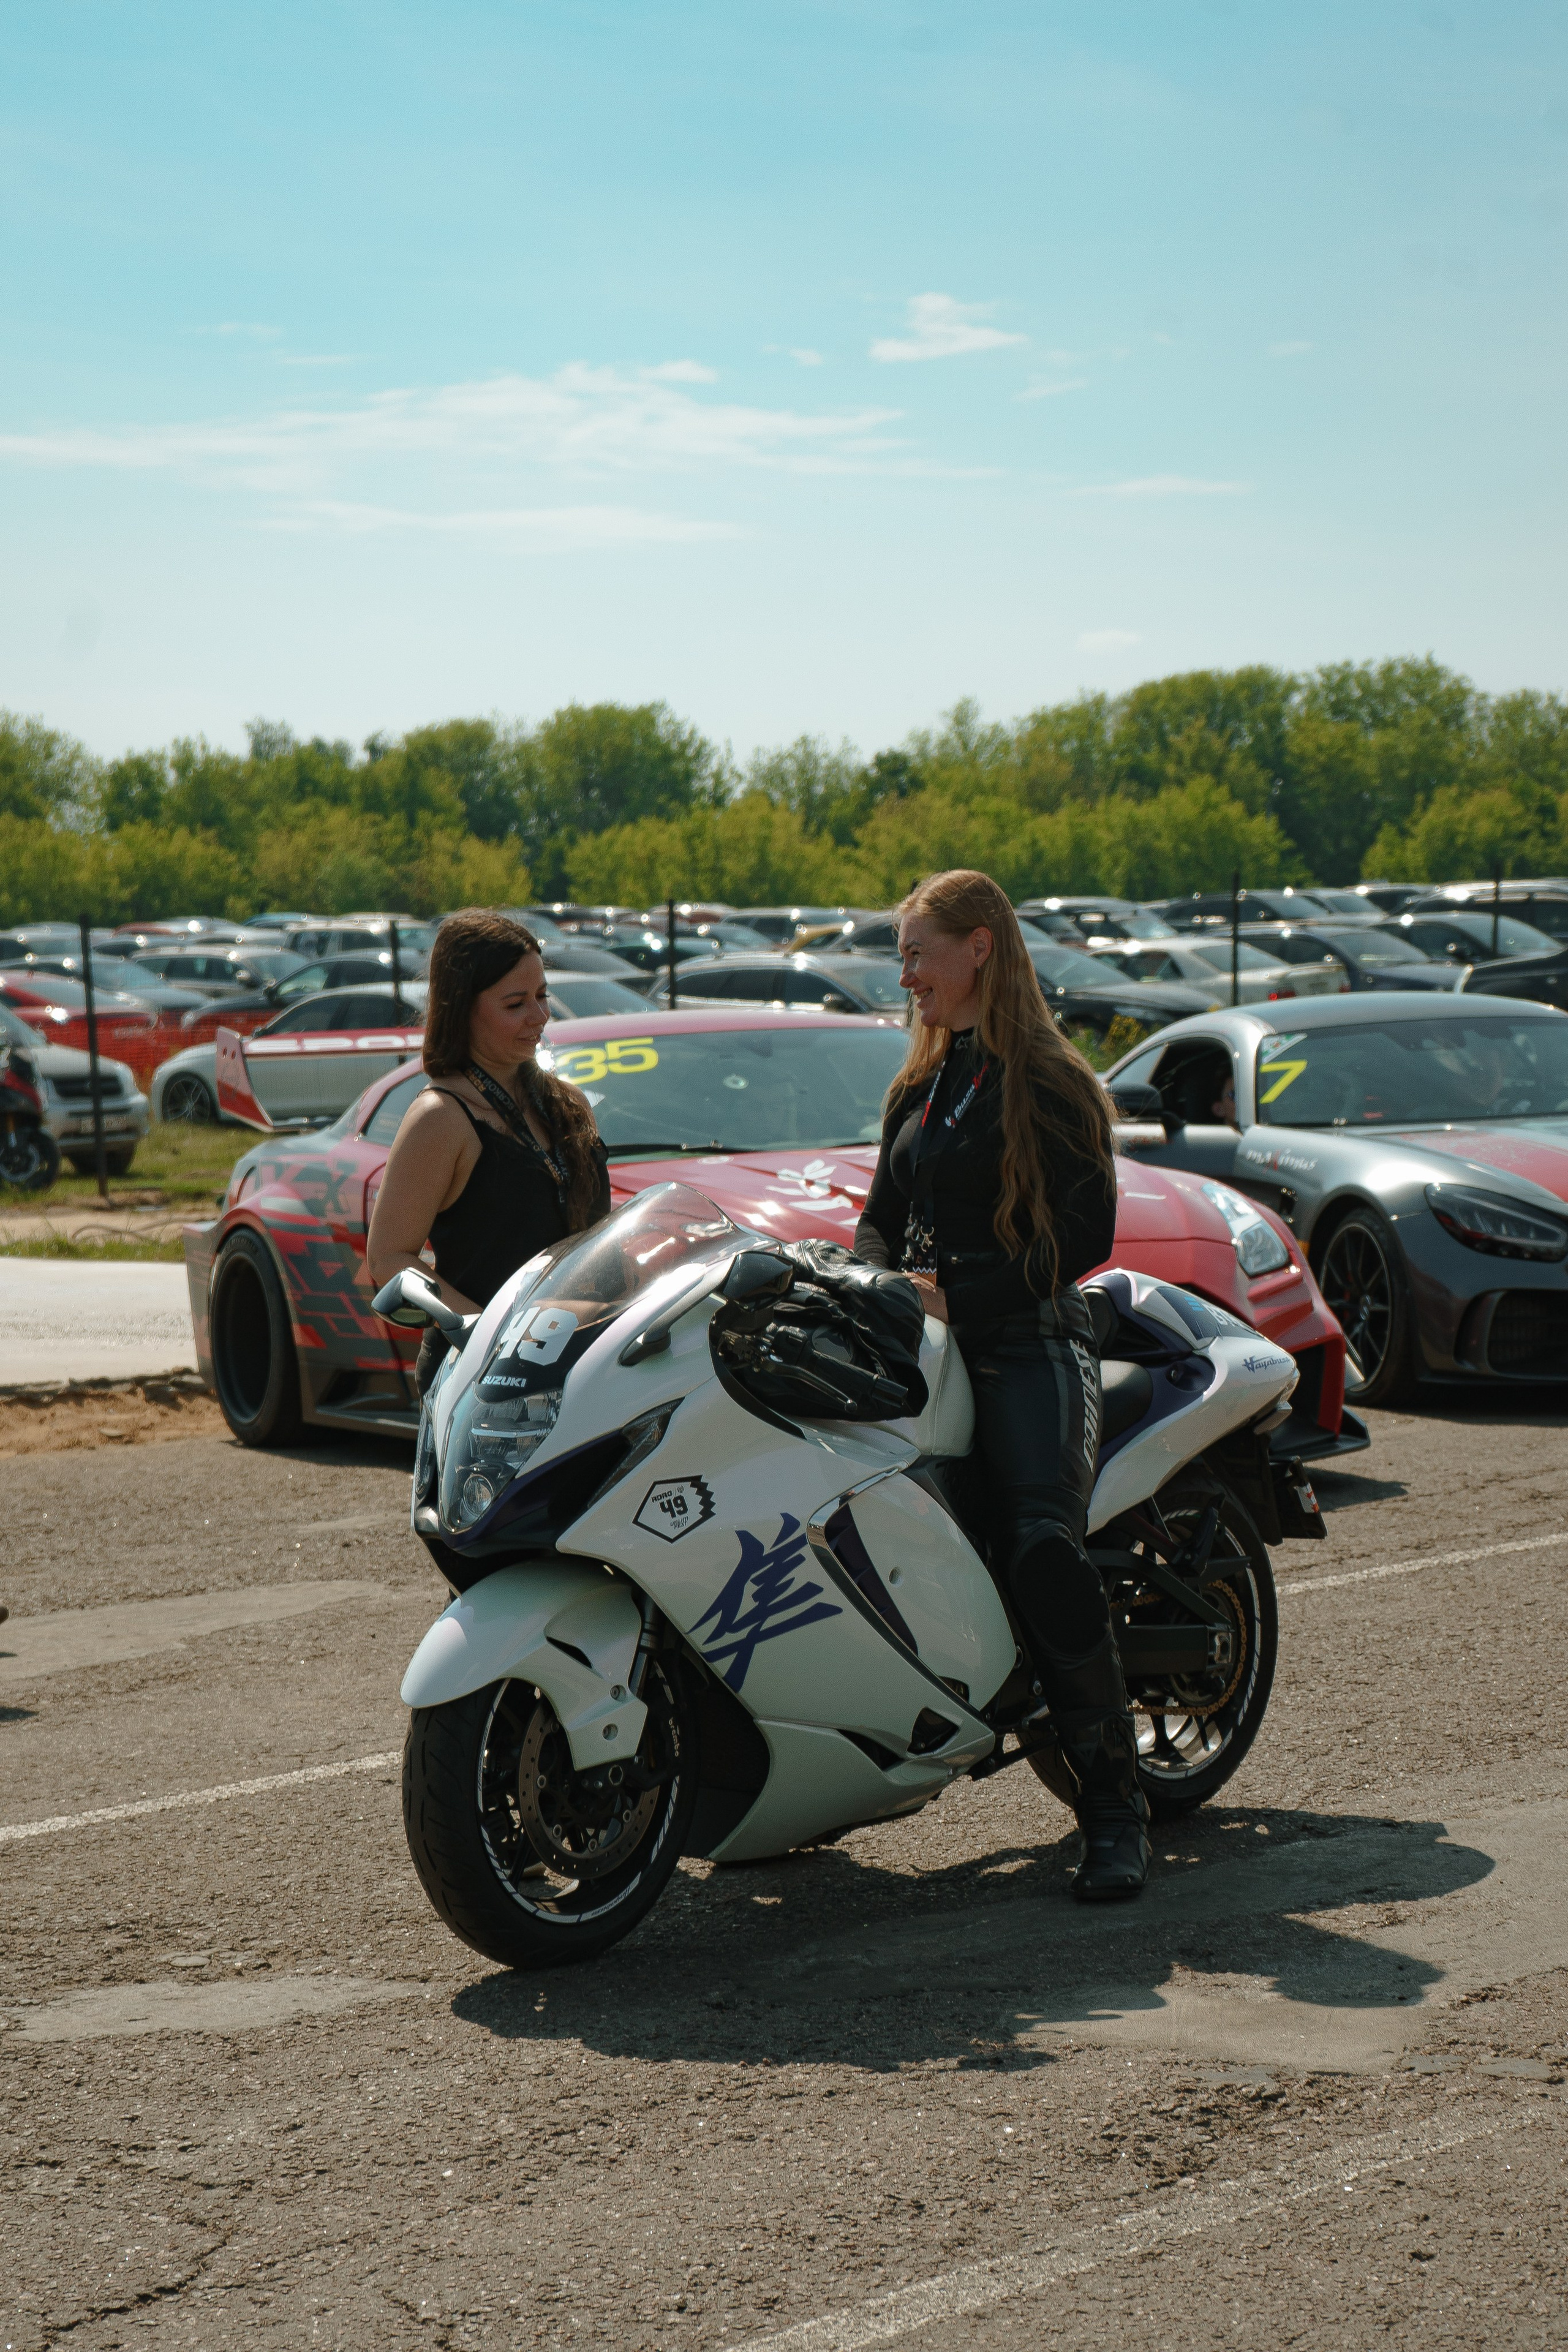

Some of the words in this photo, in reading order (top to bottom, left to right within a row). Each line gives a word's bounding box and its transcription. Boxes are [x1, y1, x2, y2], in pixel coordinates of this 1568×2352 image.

[556, 1036, 658, 1085] 35
[1259, 1060, 1307, 1104] 7
[498, 1306, 579, 1366] 49
[481, 1375, 527, 1387] SUZUKI
[1242, 1355, 1291, 1373] Hayabusa
[659, 1494, 688, 1519] 49
[668, 1717, 680, 1757] brembo
